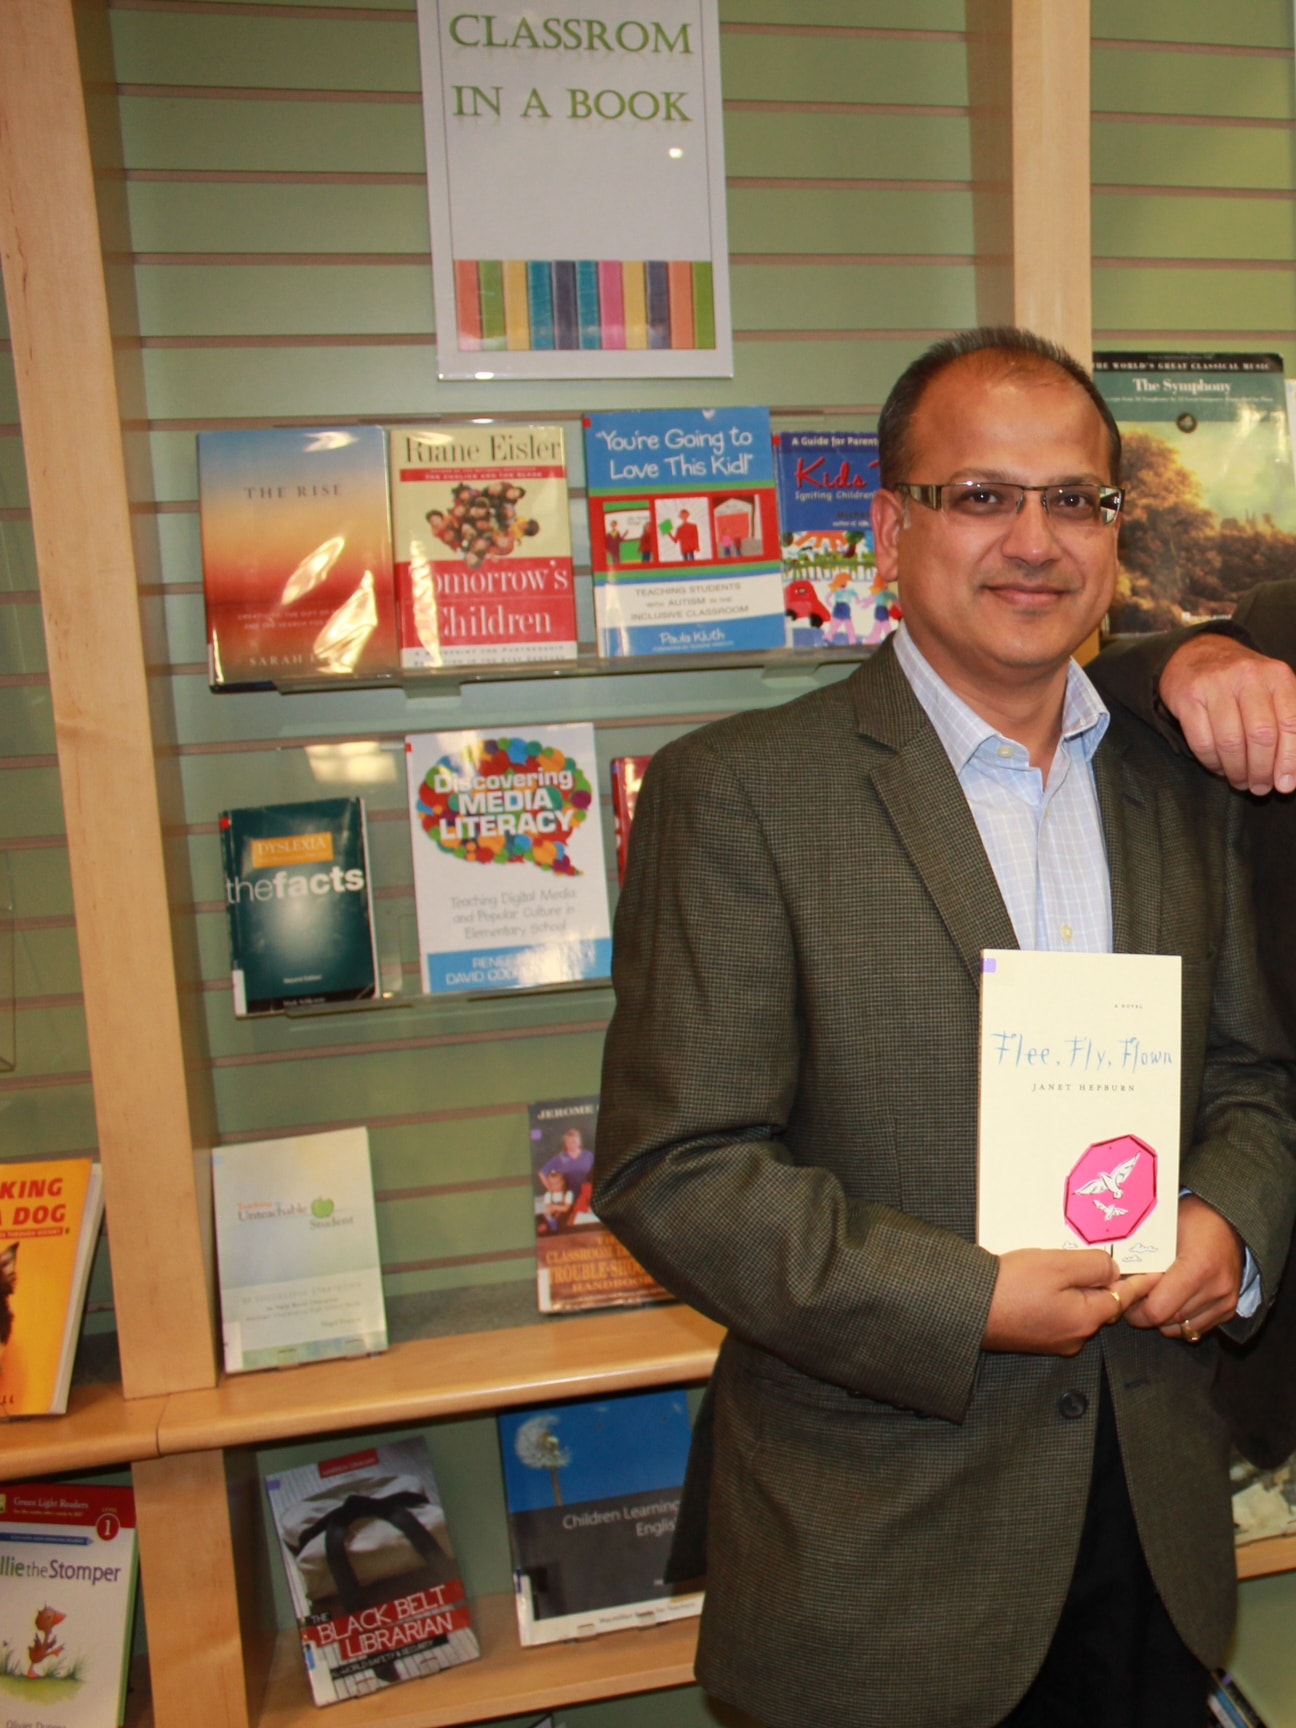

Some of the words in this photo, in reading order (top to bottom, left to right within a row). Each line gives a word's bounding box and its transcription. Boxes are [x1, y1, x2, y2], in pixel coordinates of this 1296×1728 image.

[448, 13, 693, 54] CLASSROM
[453, 86, 502, 117] IN
[521, 87, 551, 118] A
[567, 89, 692, 121] BOOK
[1132, 378, 1160, 392] The
[1162, 378, 1232, 395] Symphony
[490, 434, 561, 462] Eisler
[664, 429, 725, 454] Going
[730, 427, 753, 446] to
[791, 437, 799, 446] A
[801, 436, 829, 446] Guide
[831, 436, 846, 448] for
[848, 436, 879, 446] Parent
[609, 459, 660, 480] Love
[664, 457, 706, 477] This
[794, 457, 867, 489] Kids
[244, 487, 288, 500] THE
[296, 484, 343, 498] RISE
[434, 560, 569, 594] omorrow's
[635, 585, 687, 597] TEACHING
[689, 582, 741, 594] STUDENTS
[668, 597, 706, 607] AUTISM
[249, 655, 303, 667] SARAH
[434, 767, 574, 794] Discovering
[458, 788, 553, 815] MEDIA
[439, 810, 575, 840] LITERACY
[257, 837, 327, 856] DYSLEXIA
[451, 895, 498, 908] Teaching
[501, 890, 536, 906] Digital
[539, 887, 575, 900] Media
[452, 911, 474, 923] and
[476, 908, 518, 924] Popular
[523, 905, 561, 918] Culture
[464, 925, 526, 940] Elementary
[530, 920, 567, 934] School
[1117, 1036, 1174, 1074] Flown
[1032, 1083, 1073, 1092] JANET
[1079, 1083, 1136, 1092] HEPBURN
[537, 1103, 594, 1120] JEROME
[12, 1203, 67, 1226] DOG
[562, 1509, 621, 1530] Children
[635, 1515, 676, 1537] Englis
[317, 1604, 392, 1645] BLACK
[394, 1584, 446, 1619] BELT
[346, 1613, 454, 1657] LIBRARIAN
